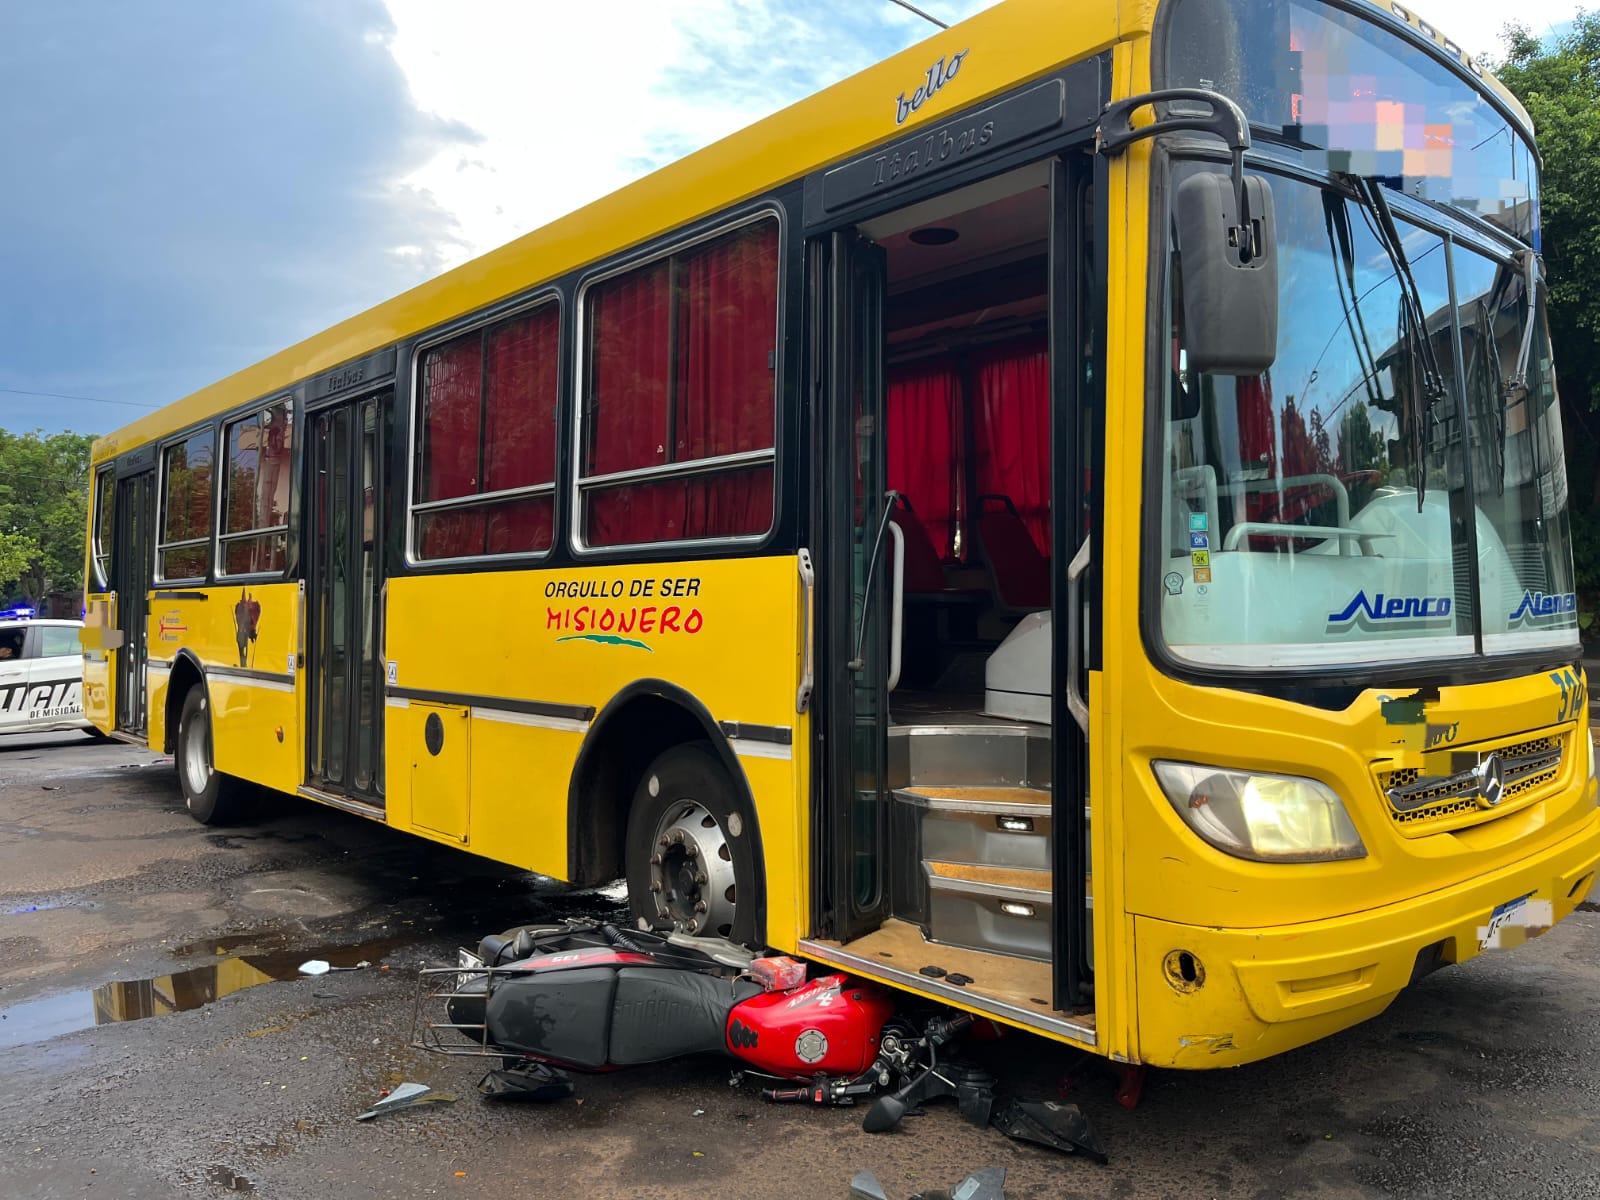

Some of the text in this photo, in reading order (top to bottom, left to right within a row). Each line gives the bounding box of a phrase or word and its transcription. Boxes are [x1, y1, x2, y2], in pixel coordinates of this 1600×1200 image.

[896, 48, 970, 125] bello
[871, 121, 994, 186] Italbus
[545, 578, 701, 598] ORGULLO DE SER
[546, 605, 703, 634] MISIONERO
[43, 704, 84, 717] MISIONE
